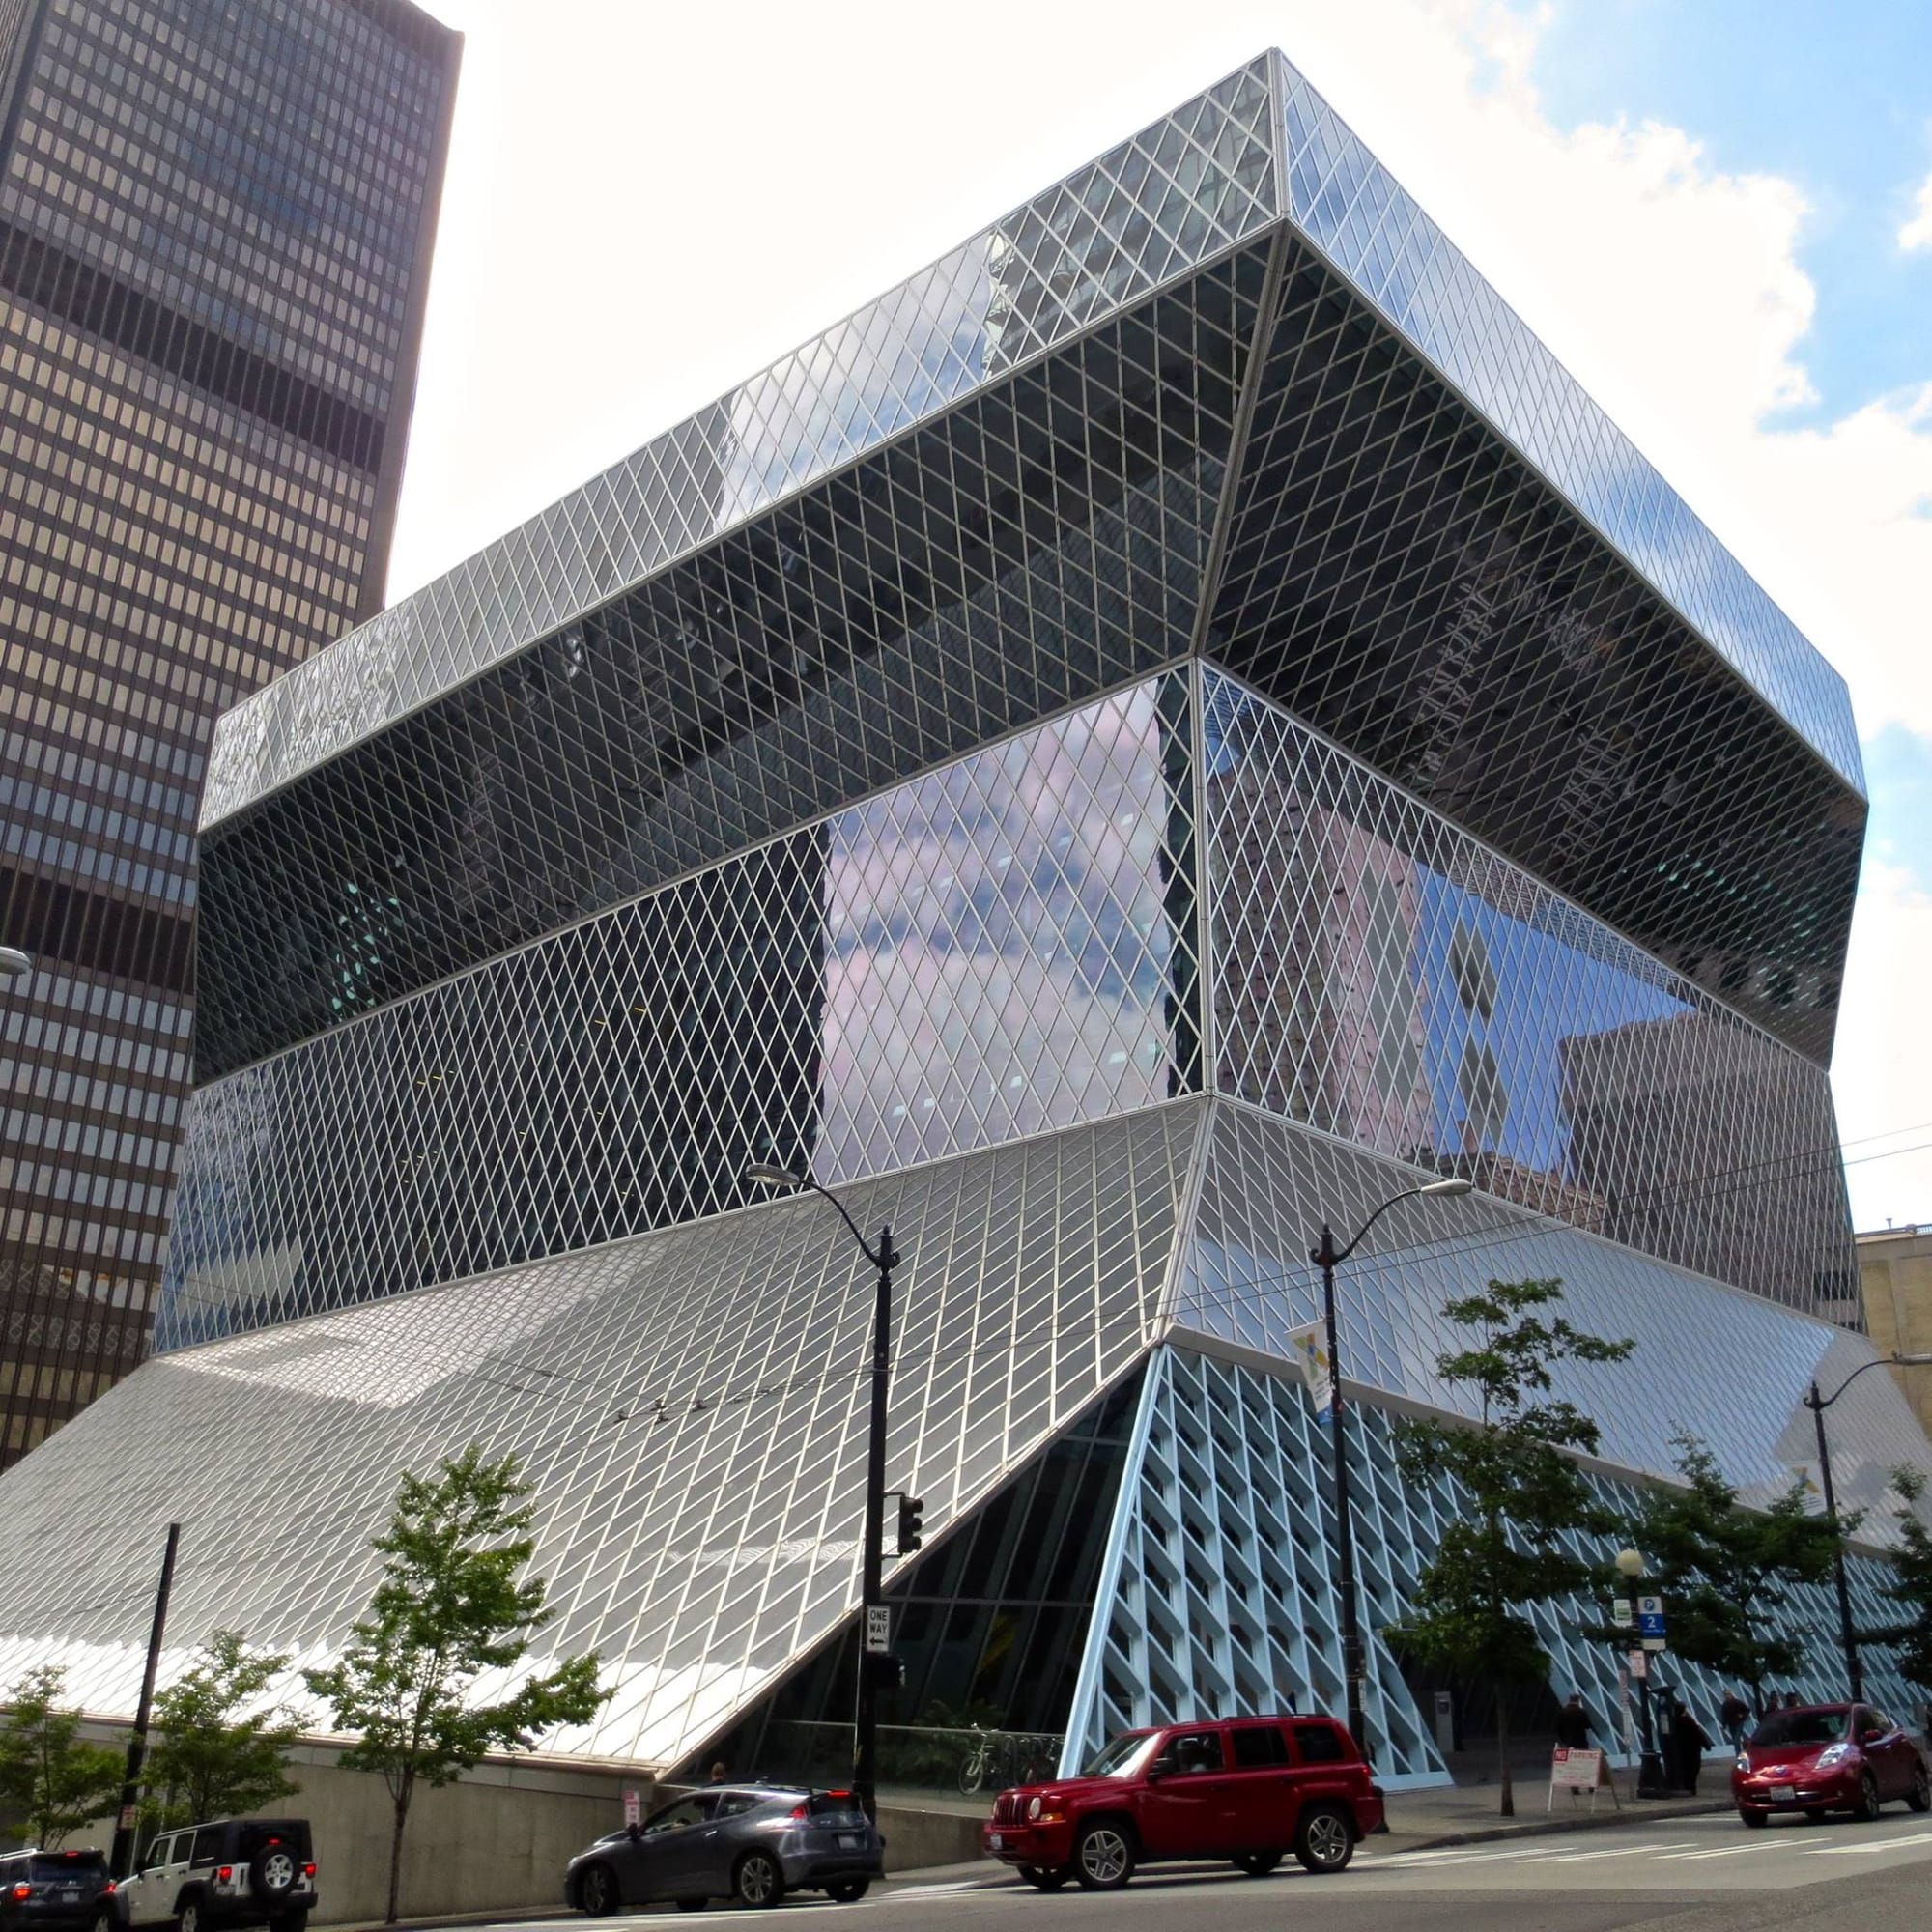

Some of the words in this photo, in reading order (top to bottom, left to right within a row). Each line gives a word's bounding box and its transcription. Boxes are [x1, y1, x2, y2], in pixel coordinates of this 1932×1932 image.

[870, 1610, 888, 1621] ONE
[1647, 1616, 1656, 1628] 2
[870, 1623, 888, 1633] WAY
